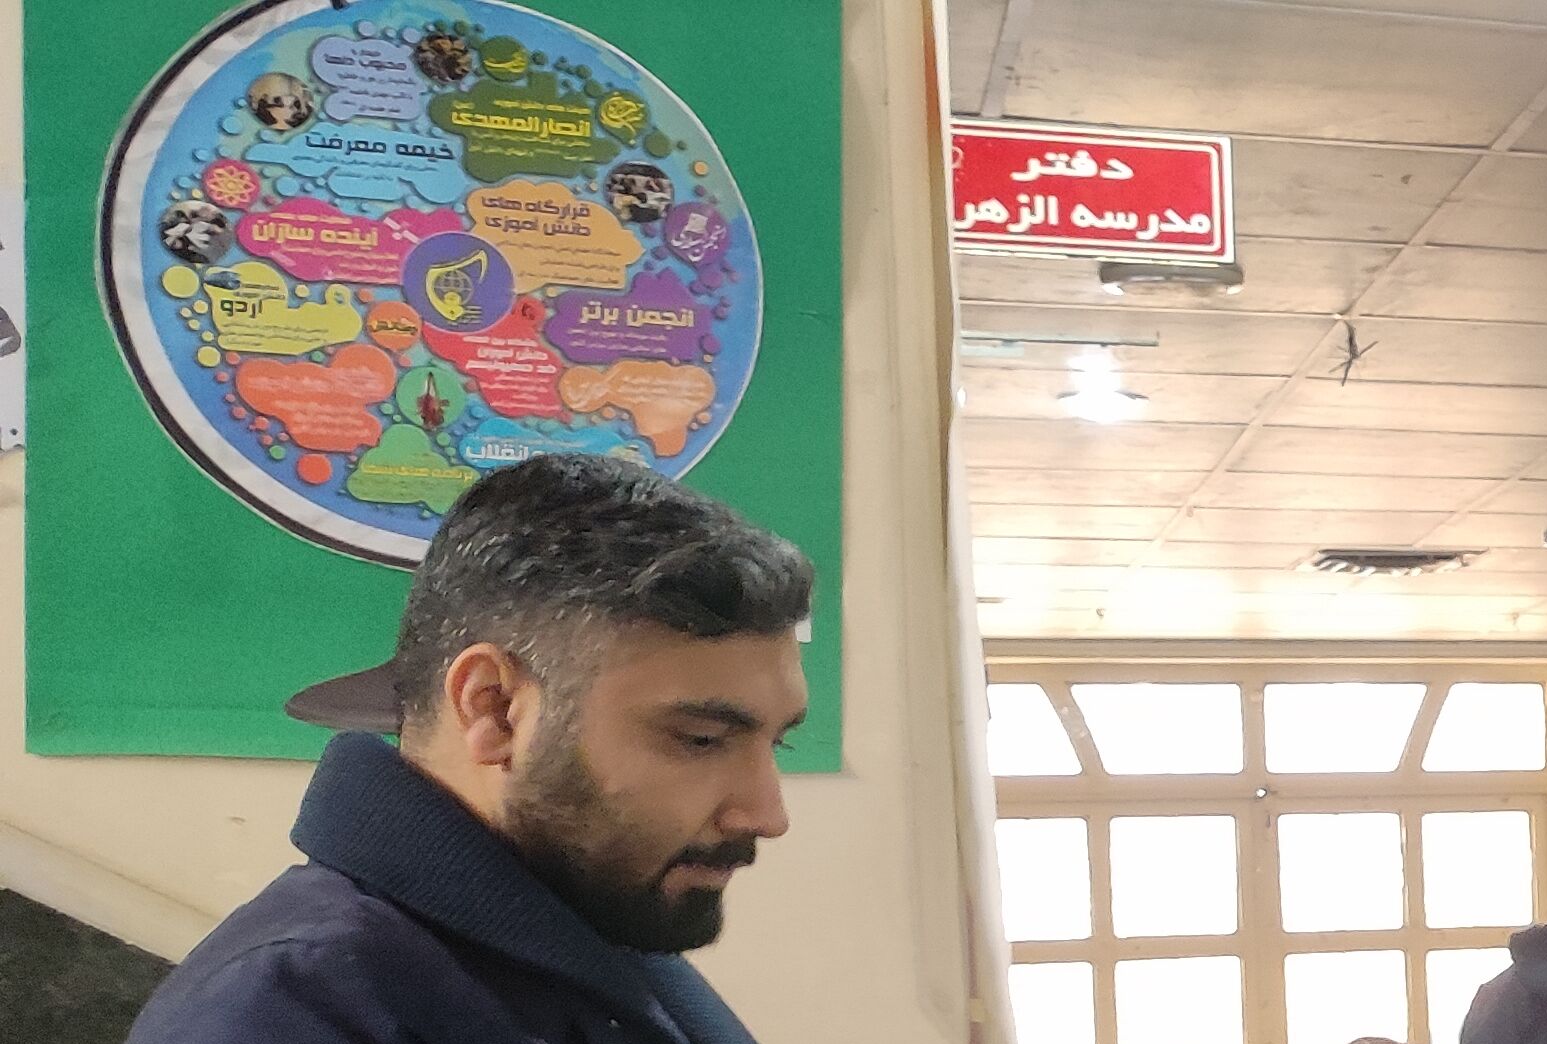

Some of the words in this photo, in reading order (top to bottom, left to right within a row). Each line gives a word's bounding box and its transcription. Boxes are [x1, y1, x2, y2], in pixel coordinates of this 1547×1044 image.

[305, 132, 387, 155] معرفت
[395, 142, 454, 162] خیمه
[1010, 150, 1134, 182] دفتر
[953, 194, 1059, 233] الزهر
[1070, 202, 1212, 240] مدرسه
[252, 219, 315, 244] سازان
[220, 300, 263, 318] اردو
[580, 301, 619, 326] برتر
[626, 304, 695, 330] انجمن
